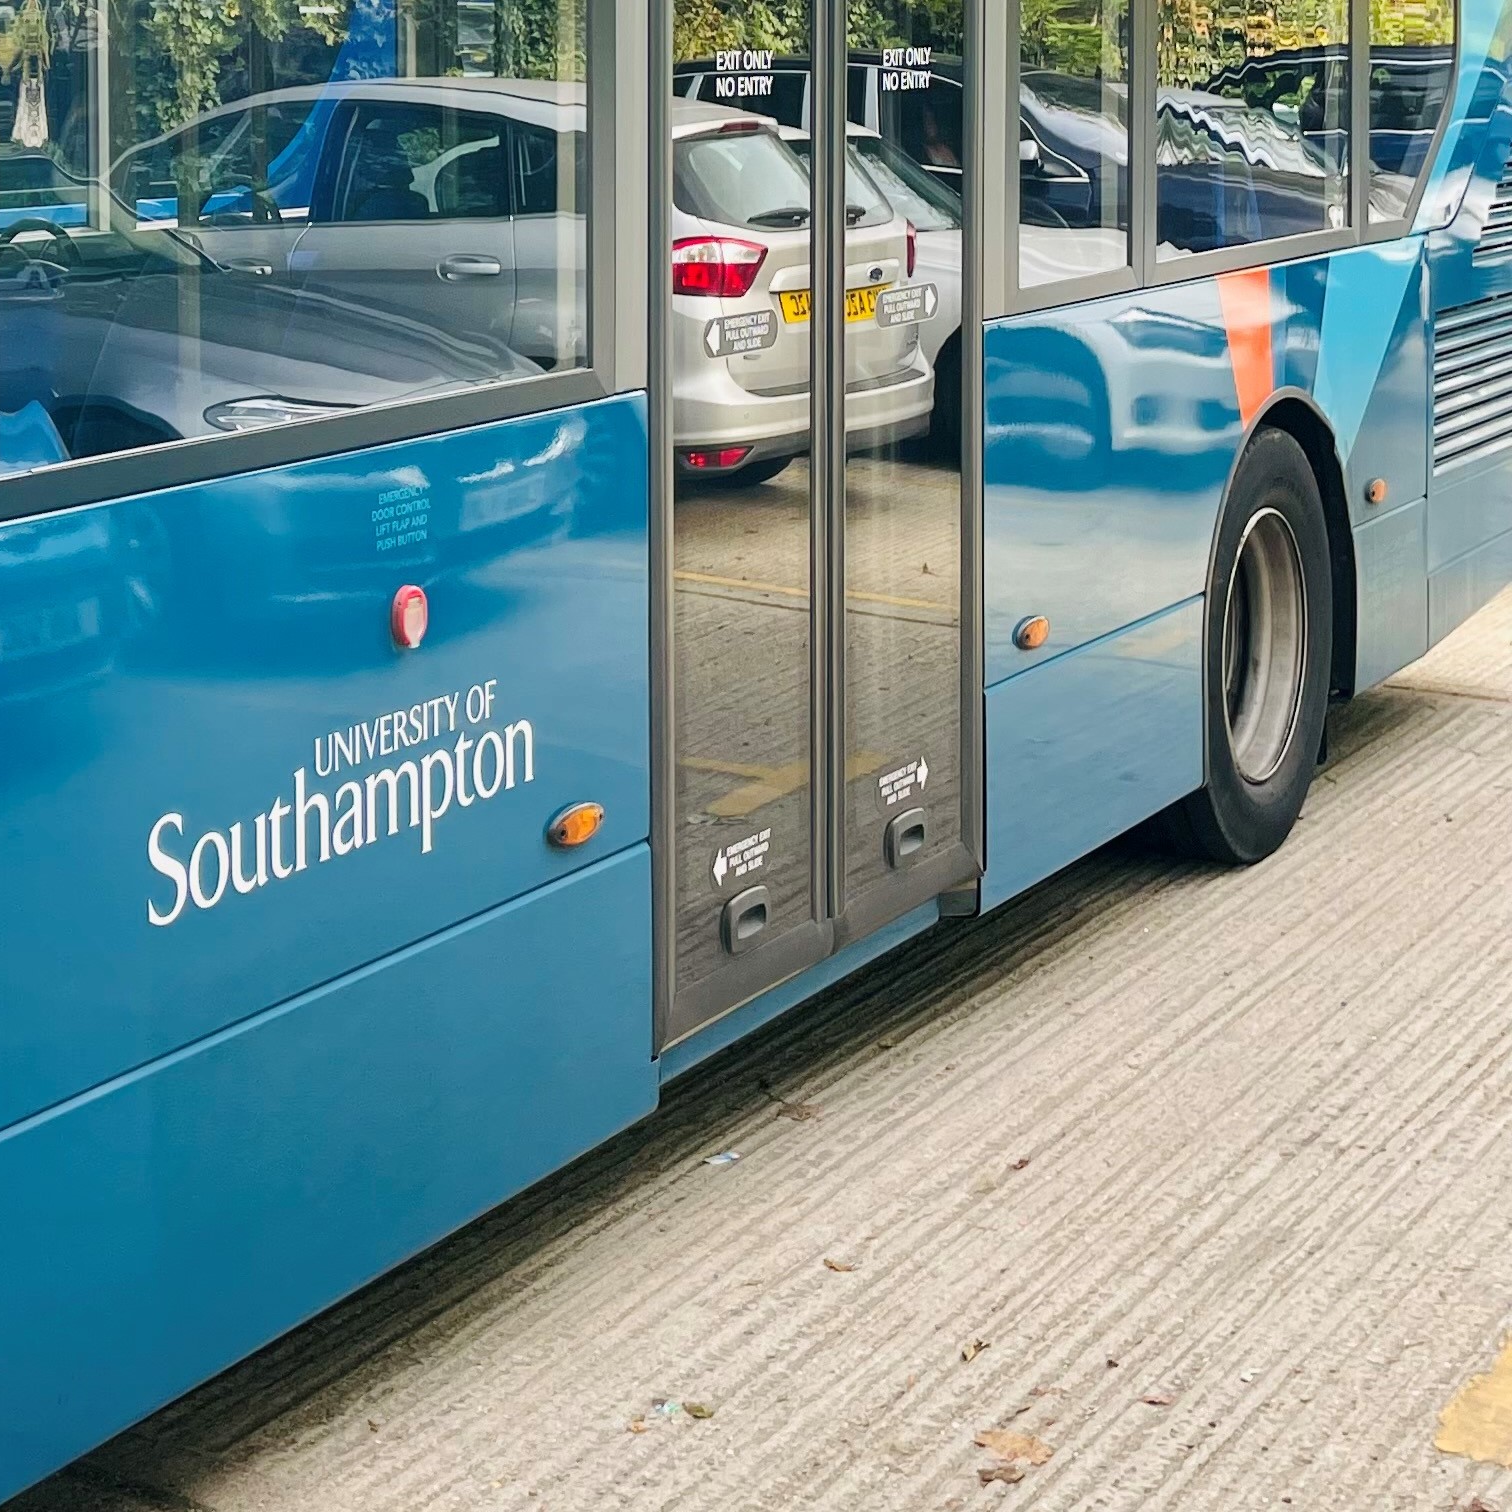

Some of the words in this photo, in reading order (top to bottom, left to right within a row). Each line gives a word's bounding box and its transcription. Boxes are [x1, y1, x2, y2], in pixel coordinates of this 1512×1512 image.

[716, 50, 742, 71] EXIT
[743, 49, 774, 70] ONLY
[883, 48, 905, 67] EXIT
[905, 46, 931, 66] ONLY
[715, 77, 736, 97] NO
[737, 75, 774, 96] ENTRY
[882, 71, 899, 91] NO
[900, 70, 931, 90] ENTRY
[378, 486, 423, 505] EMERGENCY
[371, 506, 395, 522] DOOR
[395, 497, 431, 516] CONTROL
[376, 522, 391, 537] LIFT
[392, 517, 410, 532] FLAP
[411, 514, 428, 528] AND
[376, 537, 397, 552] PUSH
[397, 529, 428, 547] BUTTON
[314, 692, 460, 777] UNIVERSITY
[465, 679, 498, 724] OF
[147, 719, 535, 927] Southampton
